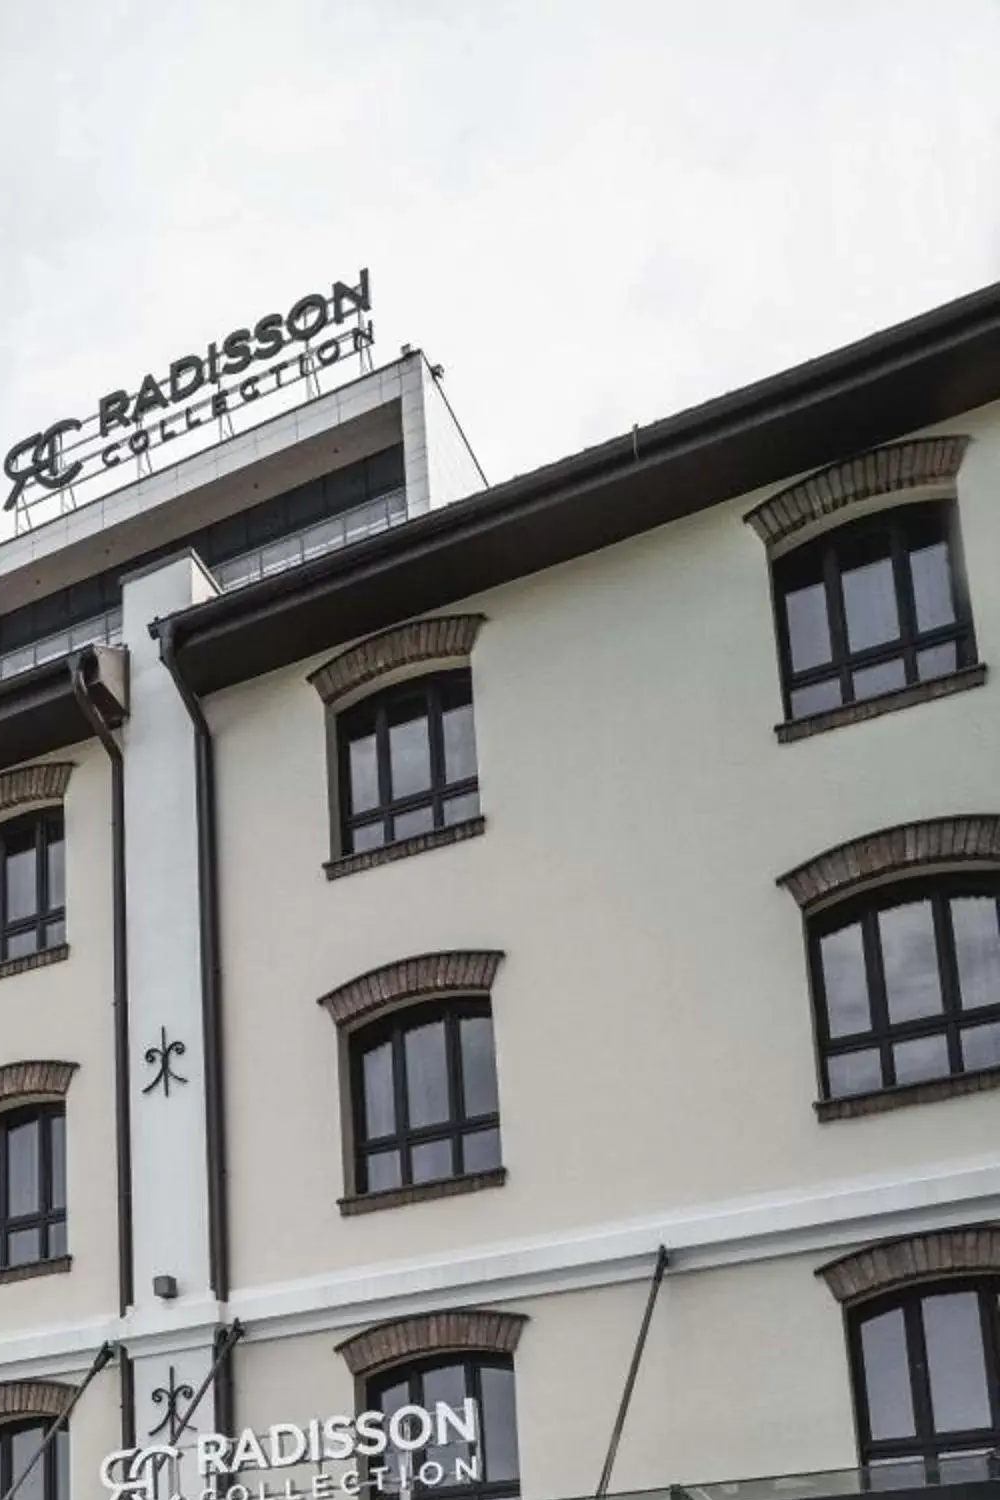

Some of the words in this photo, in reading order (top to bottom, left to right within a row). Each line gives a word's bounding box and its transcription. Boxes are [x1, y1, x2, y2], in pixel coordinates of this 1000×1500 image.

[99, 267, 371, 437] RADISSON
[101, 320, 375, 468] COLLECTION
[198, 1397, 478, 1477] RADISSON
